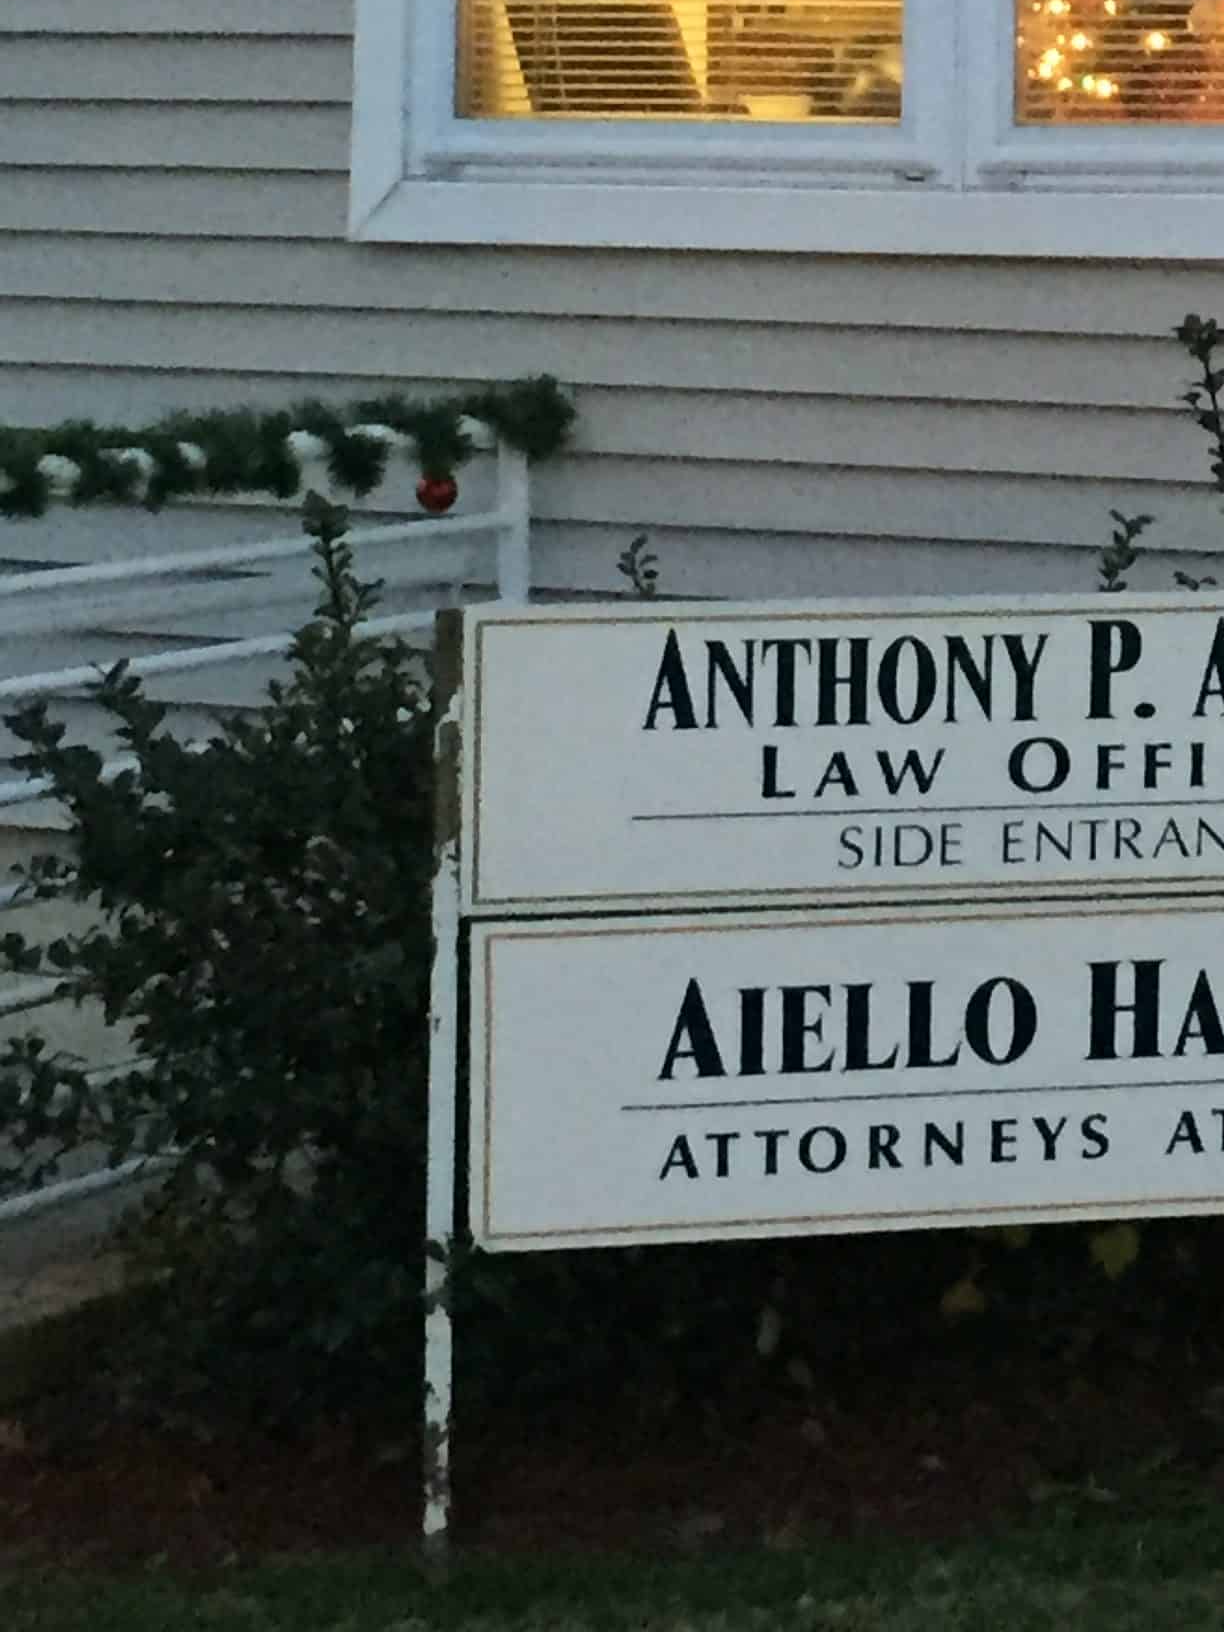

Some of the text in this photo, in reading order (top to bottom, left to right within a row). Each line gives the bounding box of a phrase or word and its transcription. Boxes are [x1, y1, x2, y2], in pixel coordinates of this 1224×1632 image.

[642, 628, 1049, 730] ANTHONY
[1085, 619, 1156, 720] P.
[761, 745, 945, 799] LAW
[839, 823, 961, 868] SIDE
[657, 976, 1037, 1081] AIELLO
[657, 1113, 1109, 1180] ATTORNEYS
